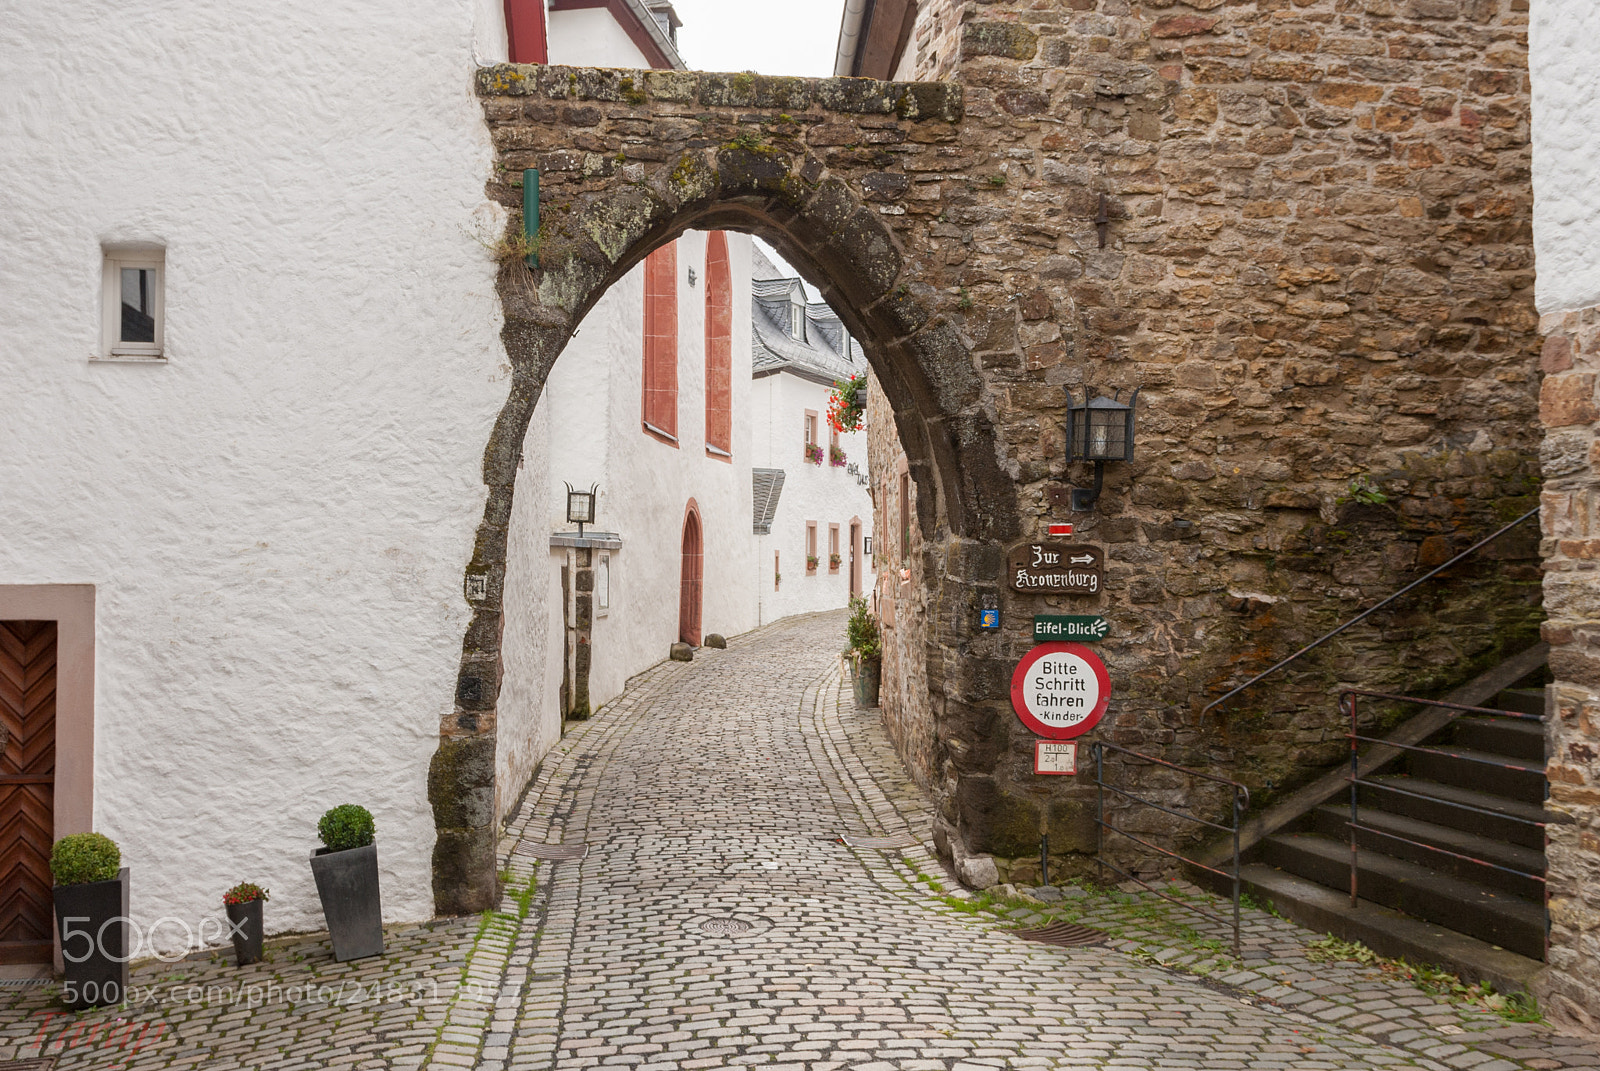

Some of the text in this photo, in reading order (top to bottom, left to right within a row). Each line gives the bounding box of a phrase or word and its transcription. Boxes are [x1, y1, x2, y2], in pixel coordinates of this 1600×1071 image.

[1032, 545, 1060, 567] Zur
[1016, 569, 1098, 592] Kronenburg
[1035, 622, 1097, 635] Eifel-Blick
[1042, 661, 1077, 675] Bitte
[1035, 677, 1086, 691] Schritt
[1036, 693, 1084, 708] fahren
